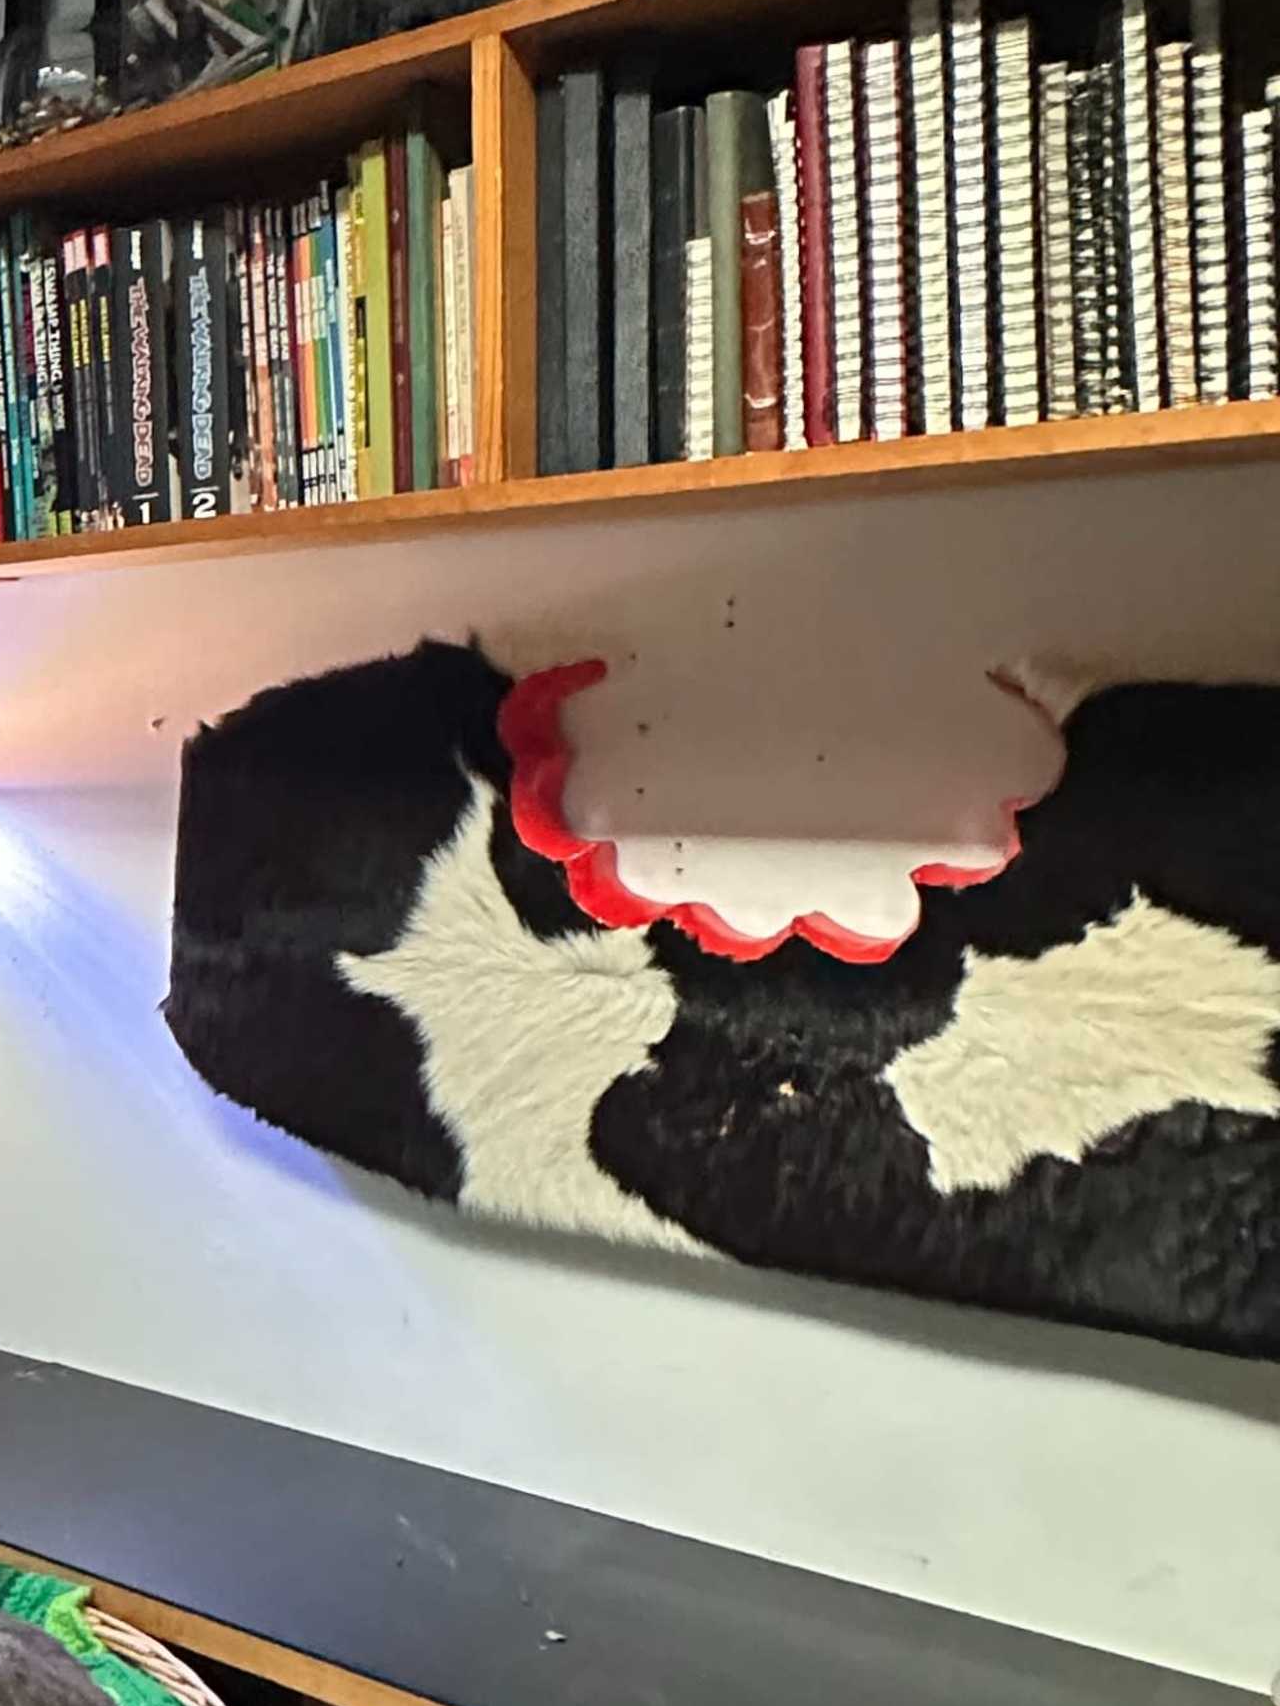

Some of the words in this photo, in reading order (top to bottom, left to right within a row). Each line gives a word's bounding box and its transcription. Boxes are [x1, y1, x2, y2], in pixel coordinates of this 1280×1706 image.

[44, 267, 59, 326] SWAMP
[48, 330, 62, 382] THING
[129, 325, 153, 421] WALKING
[188, 316, 213, 412] WALKING
[133, 422, 155, 487] DEAD
[191, 413, 215, 480] DEAD
[141, 502, 150, 523] 1
[192, 492, 217, 519] 2
